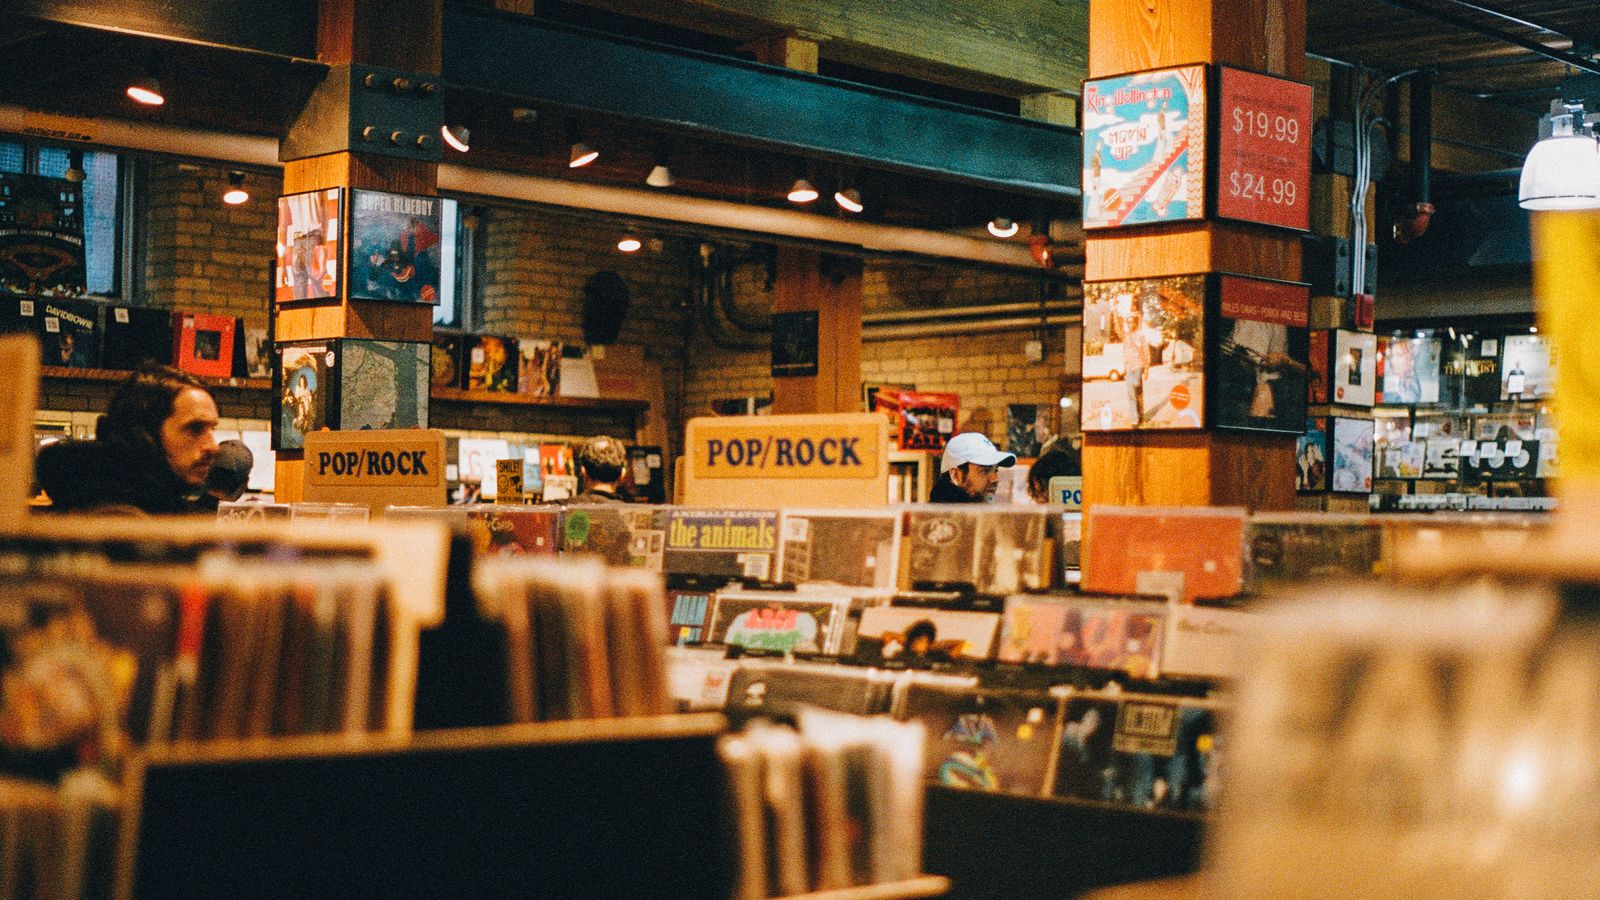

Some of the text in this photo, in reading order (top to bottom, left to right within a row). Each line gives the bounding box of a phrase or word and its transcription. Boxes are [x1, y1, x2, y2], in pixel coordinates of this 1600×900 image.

[1232, 106, 1298, 144] $19.99
[1114, 146, 1133, 160] UP
[1230, 170, 1296, 206] $24.99
[319, 449, 428, 477] POP/ROCK
[707, 435, 862, 469] POP/ROCK
[669, 514, 697, 549] the
[700, 517, 775, 549] animals
